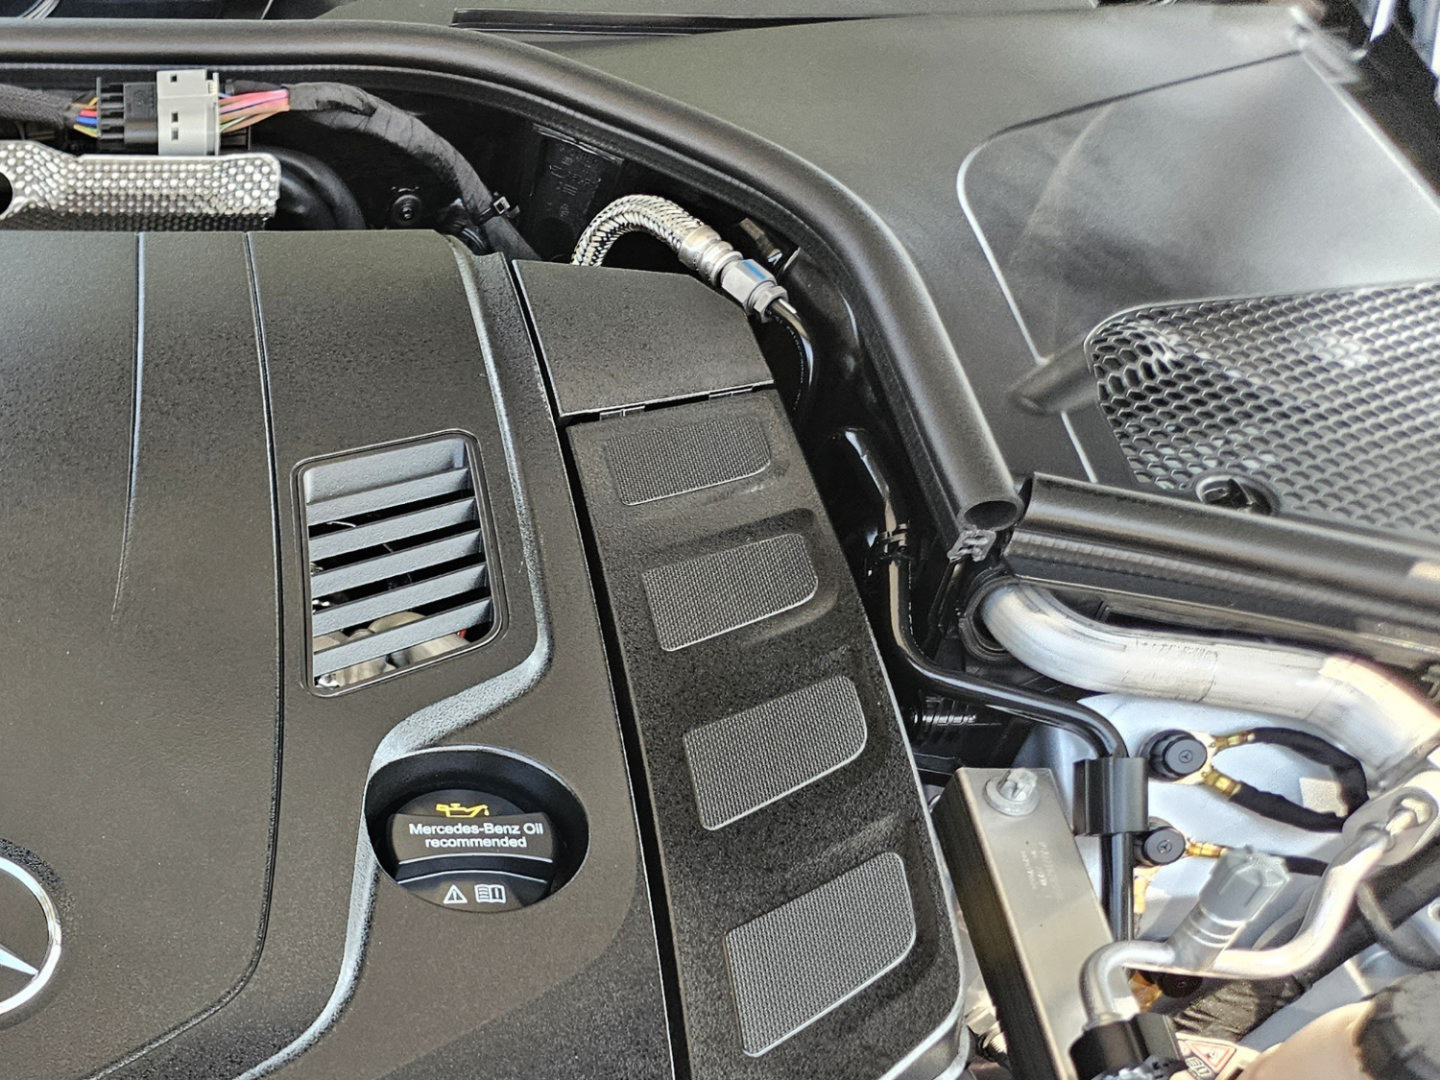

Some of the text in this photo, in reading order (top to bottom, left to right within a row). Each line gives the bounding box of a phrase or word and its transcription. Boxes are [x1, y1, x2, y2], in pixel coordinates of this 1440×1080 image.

[409, 823, 544, 835] Mercedes-Benz Oil
[425, 836, 527, 848] recommended
